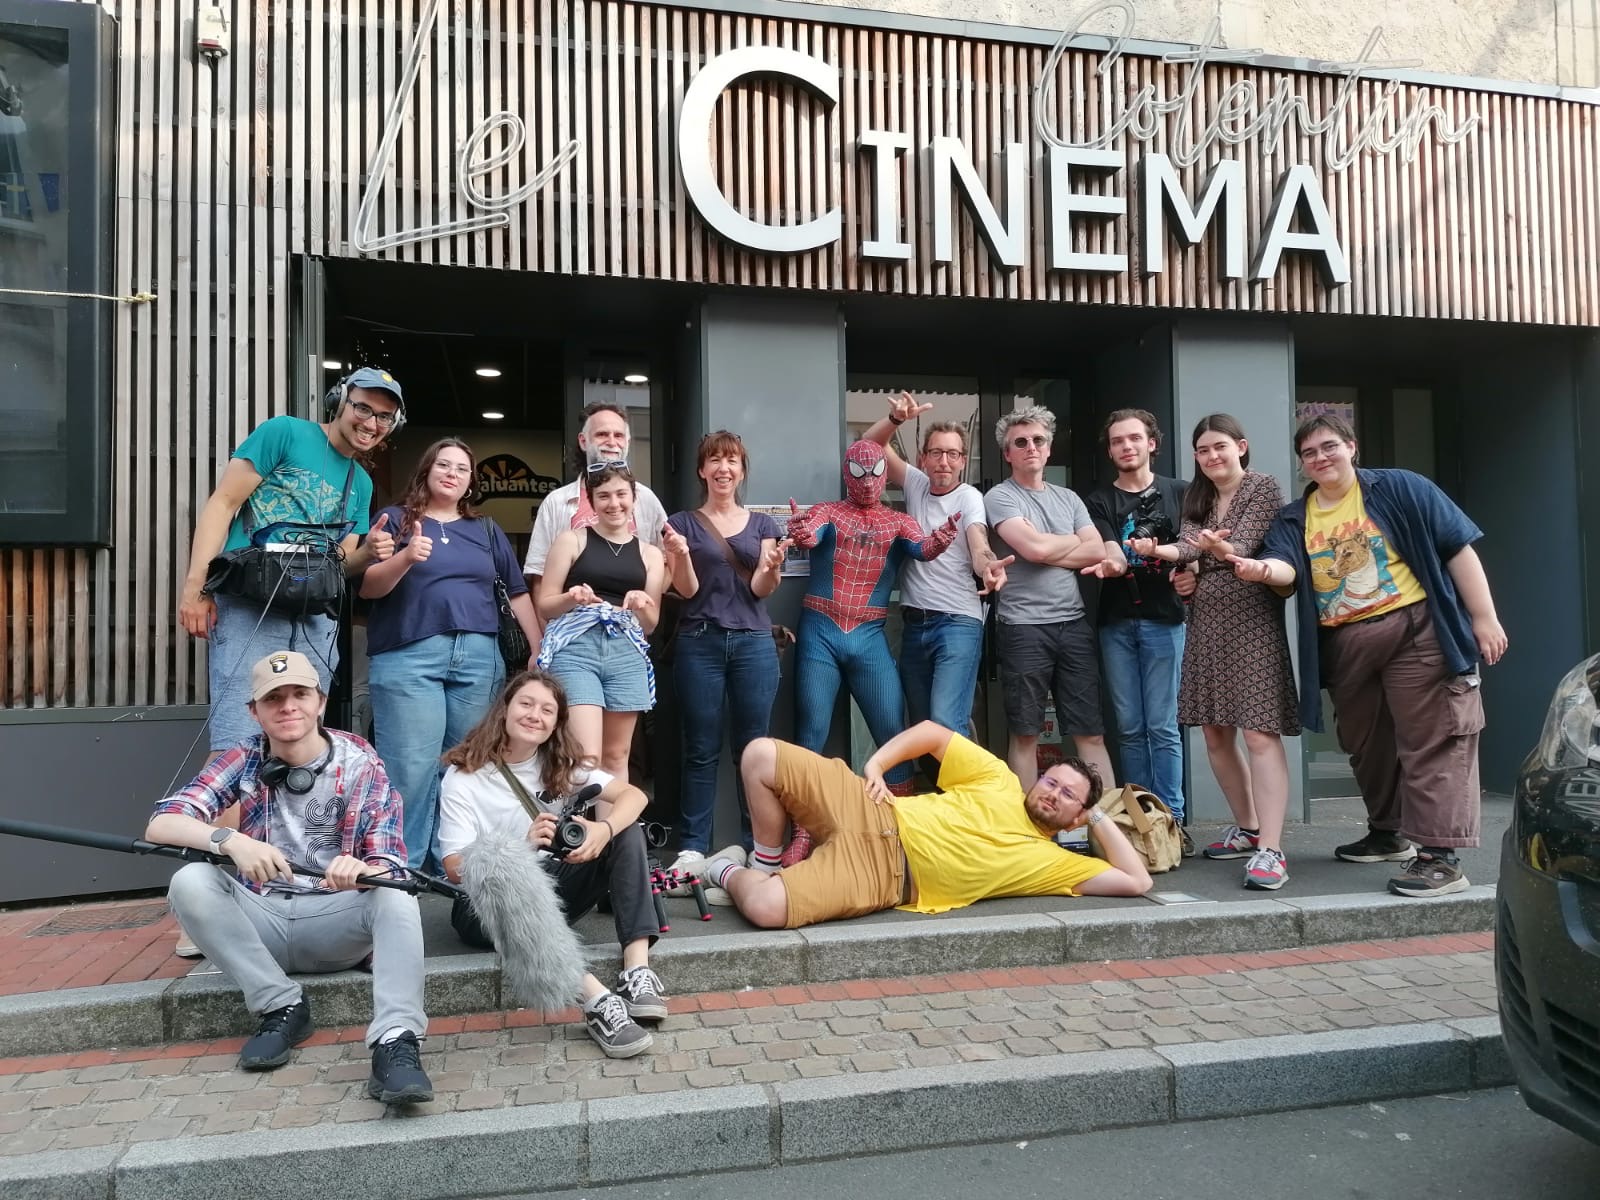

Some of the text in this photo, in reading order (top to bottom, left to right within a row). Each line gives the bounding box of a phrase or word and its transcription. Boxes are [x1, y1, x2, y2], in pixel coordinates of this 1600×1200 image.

[354, 0, 581, 252] Le
[678, 45, 1351, 288] CINEMA
[1035, 0, 1481, 172] Cotentin
